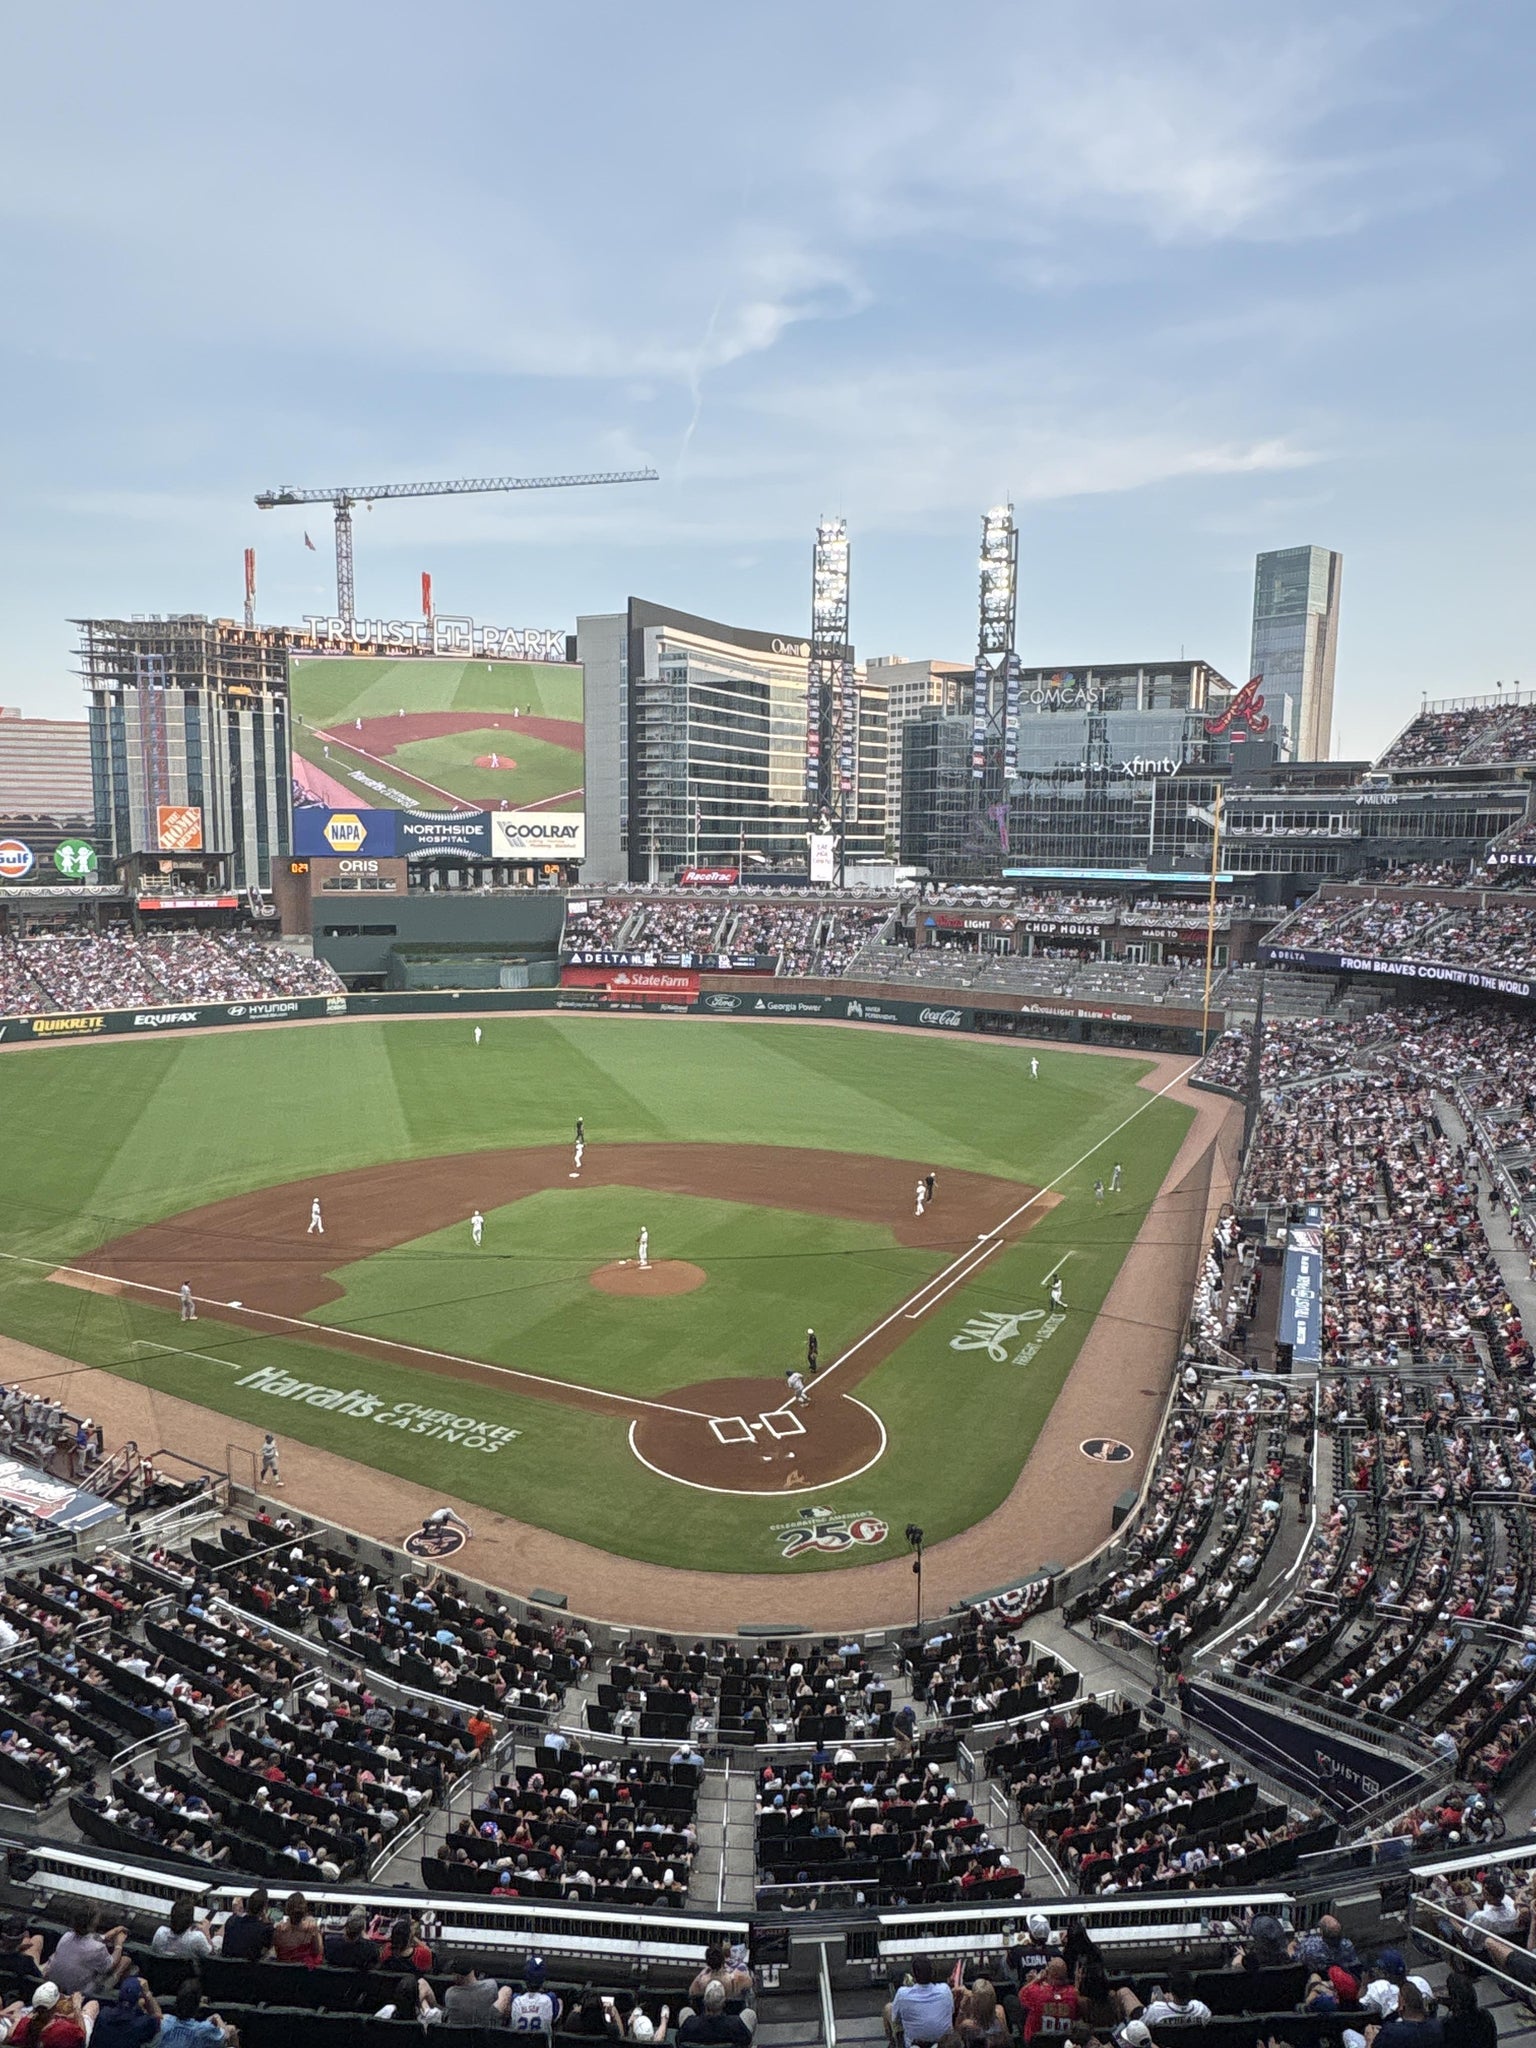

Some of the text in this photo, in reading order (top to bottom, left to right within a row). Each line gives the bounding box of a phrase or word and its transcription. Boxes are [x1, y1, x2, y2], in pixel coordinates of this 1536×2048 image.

[303, 616, 566, 655] TRUIST PARK
[771, 638, 800, 657] OMNI
[1017, 686, 1108, 705] COMCAST
[1120, 755, 1182, 776] xfinity
[1364, 795, 1399, 805] MILNER
[159, 807, 200, 848] HOME
[331, 825, 361, 841] NAPA
[403, 824, 484, 835] NORTHSIDE
[504, 824, 580, 839] COOLRAY
[418, 836, 470, 844] HOSPITAL
[339, 859, 379, 872] ORIS
[686, 872, 732, 882] RaceTrac
[964, 920, 991, 930] LIGHT
[1025, 922, 1100, 936] CHOP HOUSE
[1142, 930, 1165, 938] MADE
[1166, 931, 1178, 939] TO
[584, 953, 628, 964] DELTA
[1278, 953, 1306, 962] DELTA
[1340, 957, 1531, 996] FROM BRAVES COUNTRY TO THE WORLD
[249, 1002, 299, 1014] HYUNDAI
[711, 997, 735, 1008] Ford
[767, 1001, 822, 1012] Georgia Power
[32, 1016, 105, 1032] QUIKRETE
[134, 1012, 198, 1027] EQUIFAX
[949, 1309, 1046, 1363] SAIA
[392, 1402, 524, 1443] CHEROKEE
[372, 1411, 506, 1453] CASINOS
